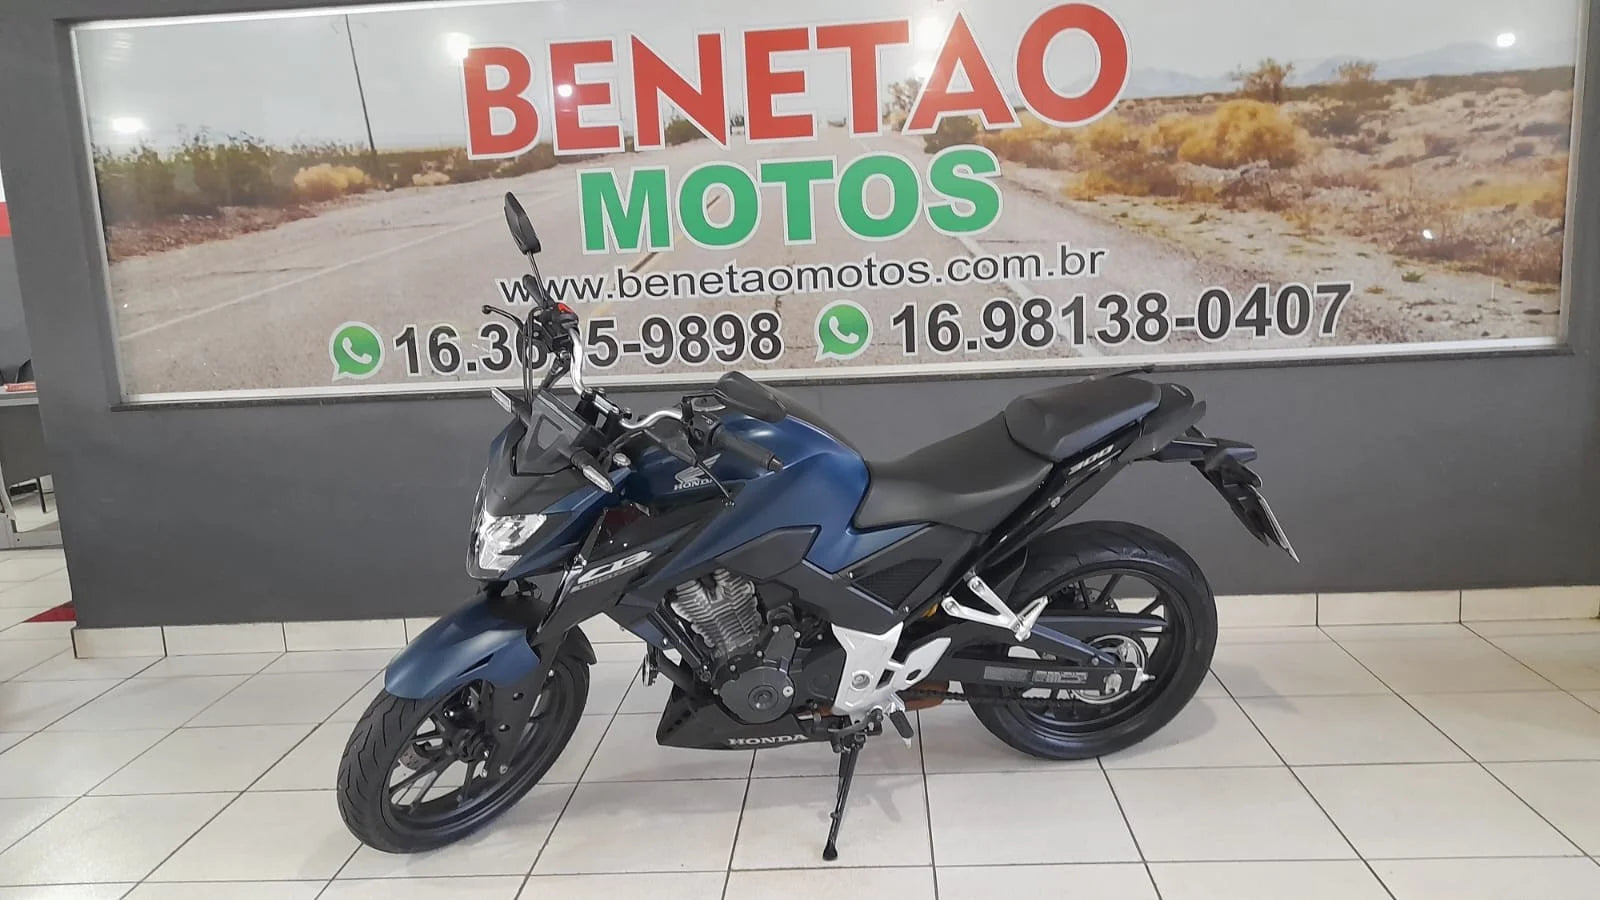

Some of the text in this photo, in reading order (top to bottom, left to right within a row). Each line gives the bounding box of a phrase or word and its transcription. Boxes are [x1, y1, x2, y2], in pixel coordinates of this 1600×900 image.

[463, 3, 1128, 156] BENETAO
[580, 149, 1001, 251] MOTOS
[500, 246, 1105, 302] www.benetaomotos.com.br
[395, 313, 782, 373] 16.365-9898
[892, 284, 1353, 353] 16.98138-0407
[674, 479, 713, 490] HOND
[728, 734, 808, 745] HONDA
